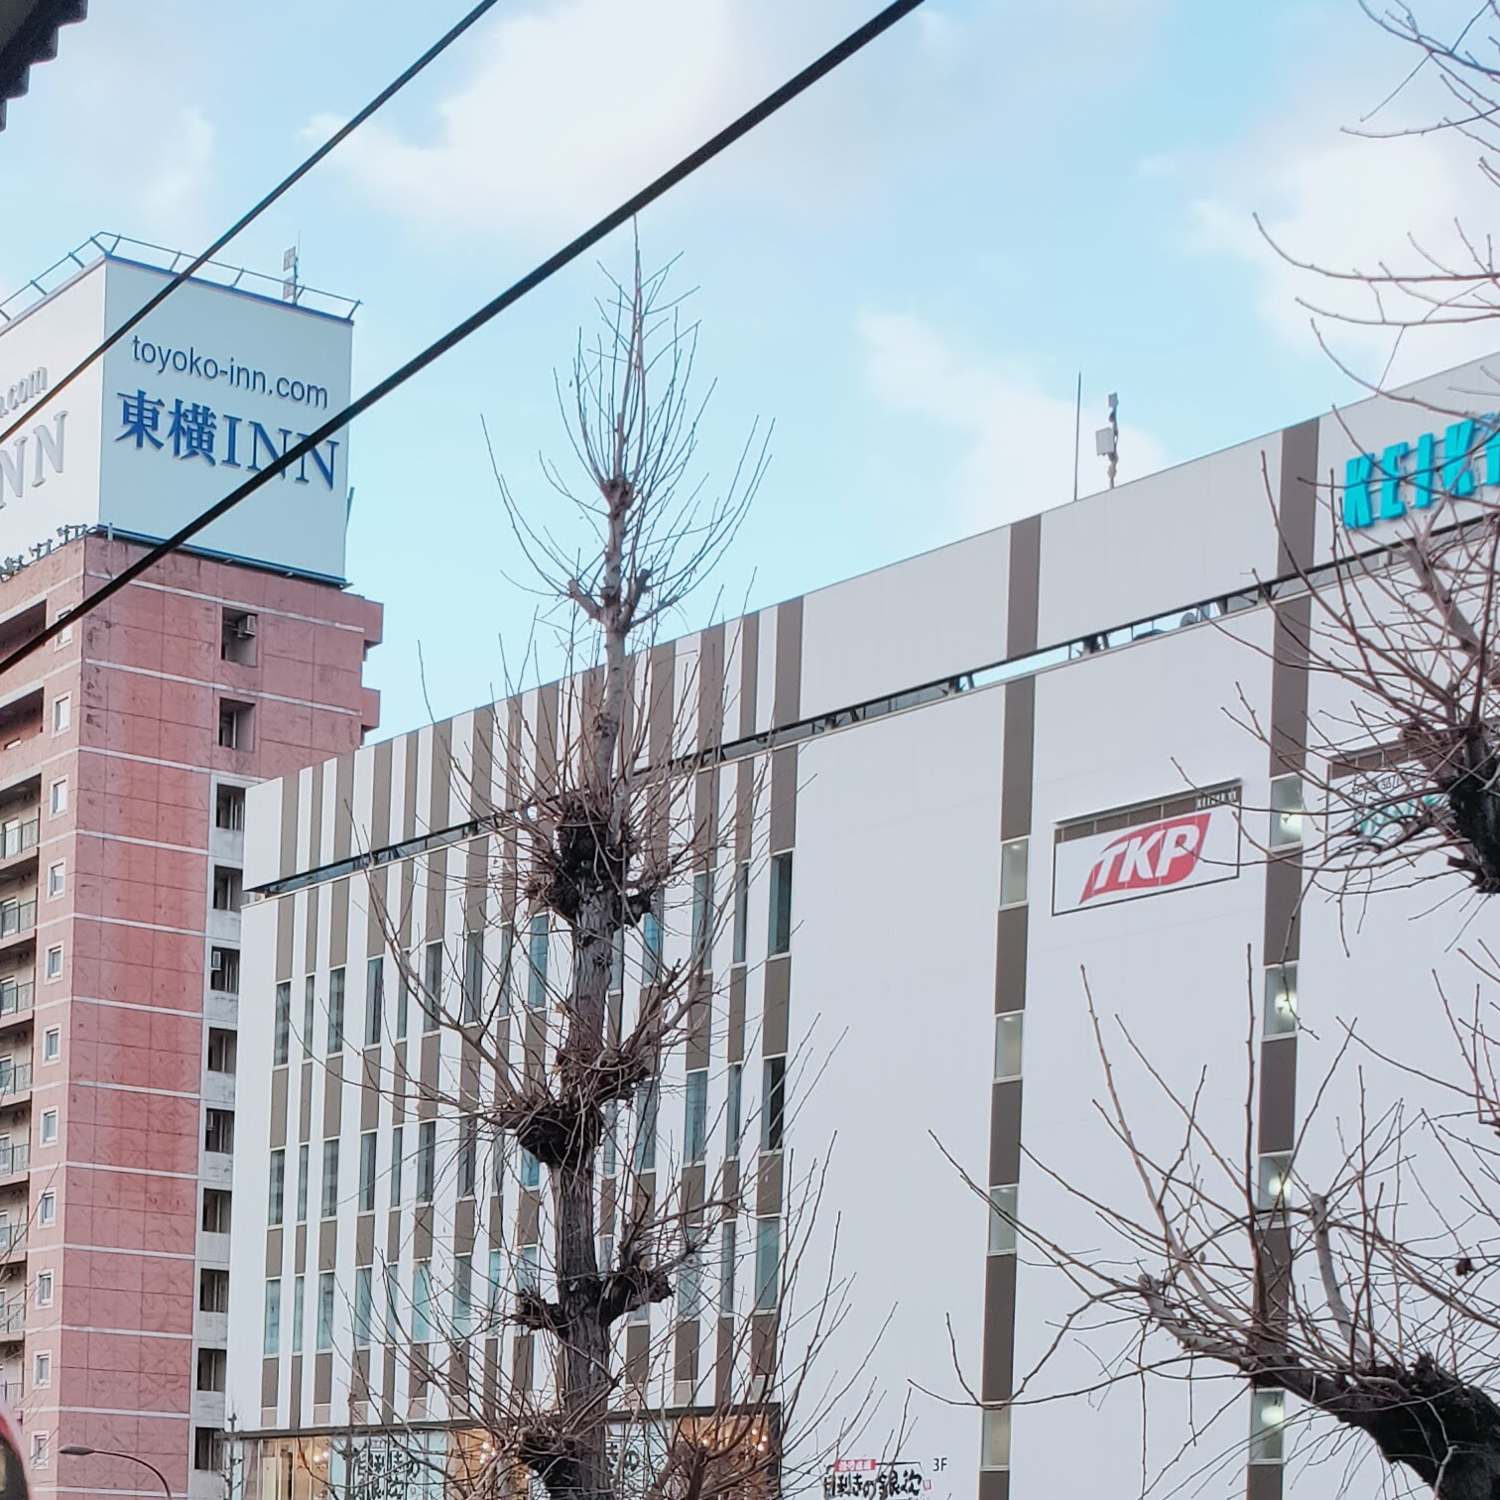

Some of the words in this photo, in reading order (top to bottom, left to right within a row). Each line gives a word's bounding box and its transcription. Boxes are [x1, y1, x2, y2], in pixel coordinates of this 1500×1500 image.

[133, 335, 329, 410] toyoko-inn.com
[114, 388, 341, 491] 東横INN
[1092, 824, 1200, 892] TKP
[933, 1457, 948, 1472] 3F
